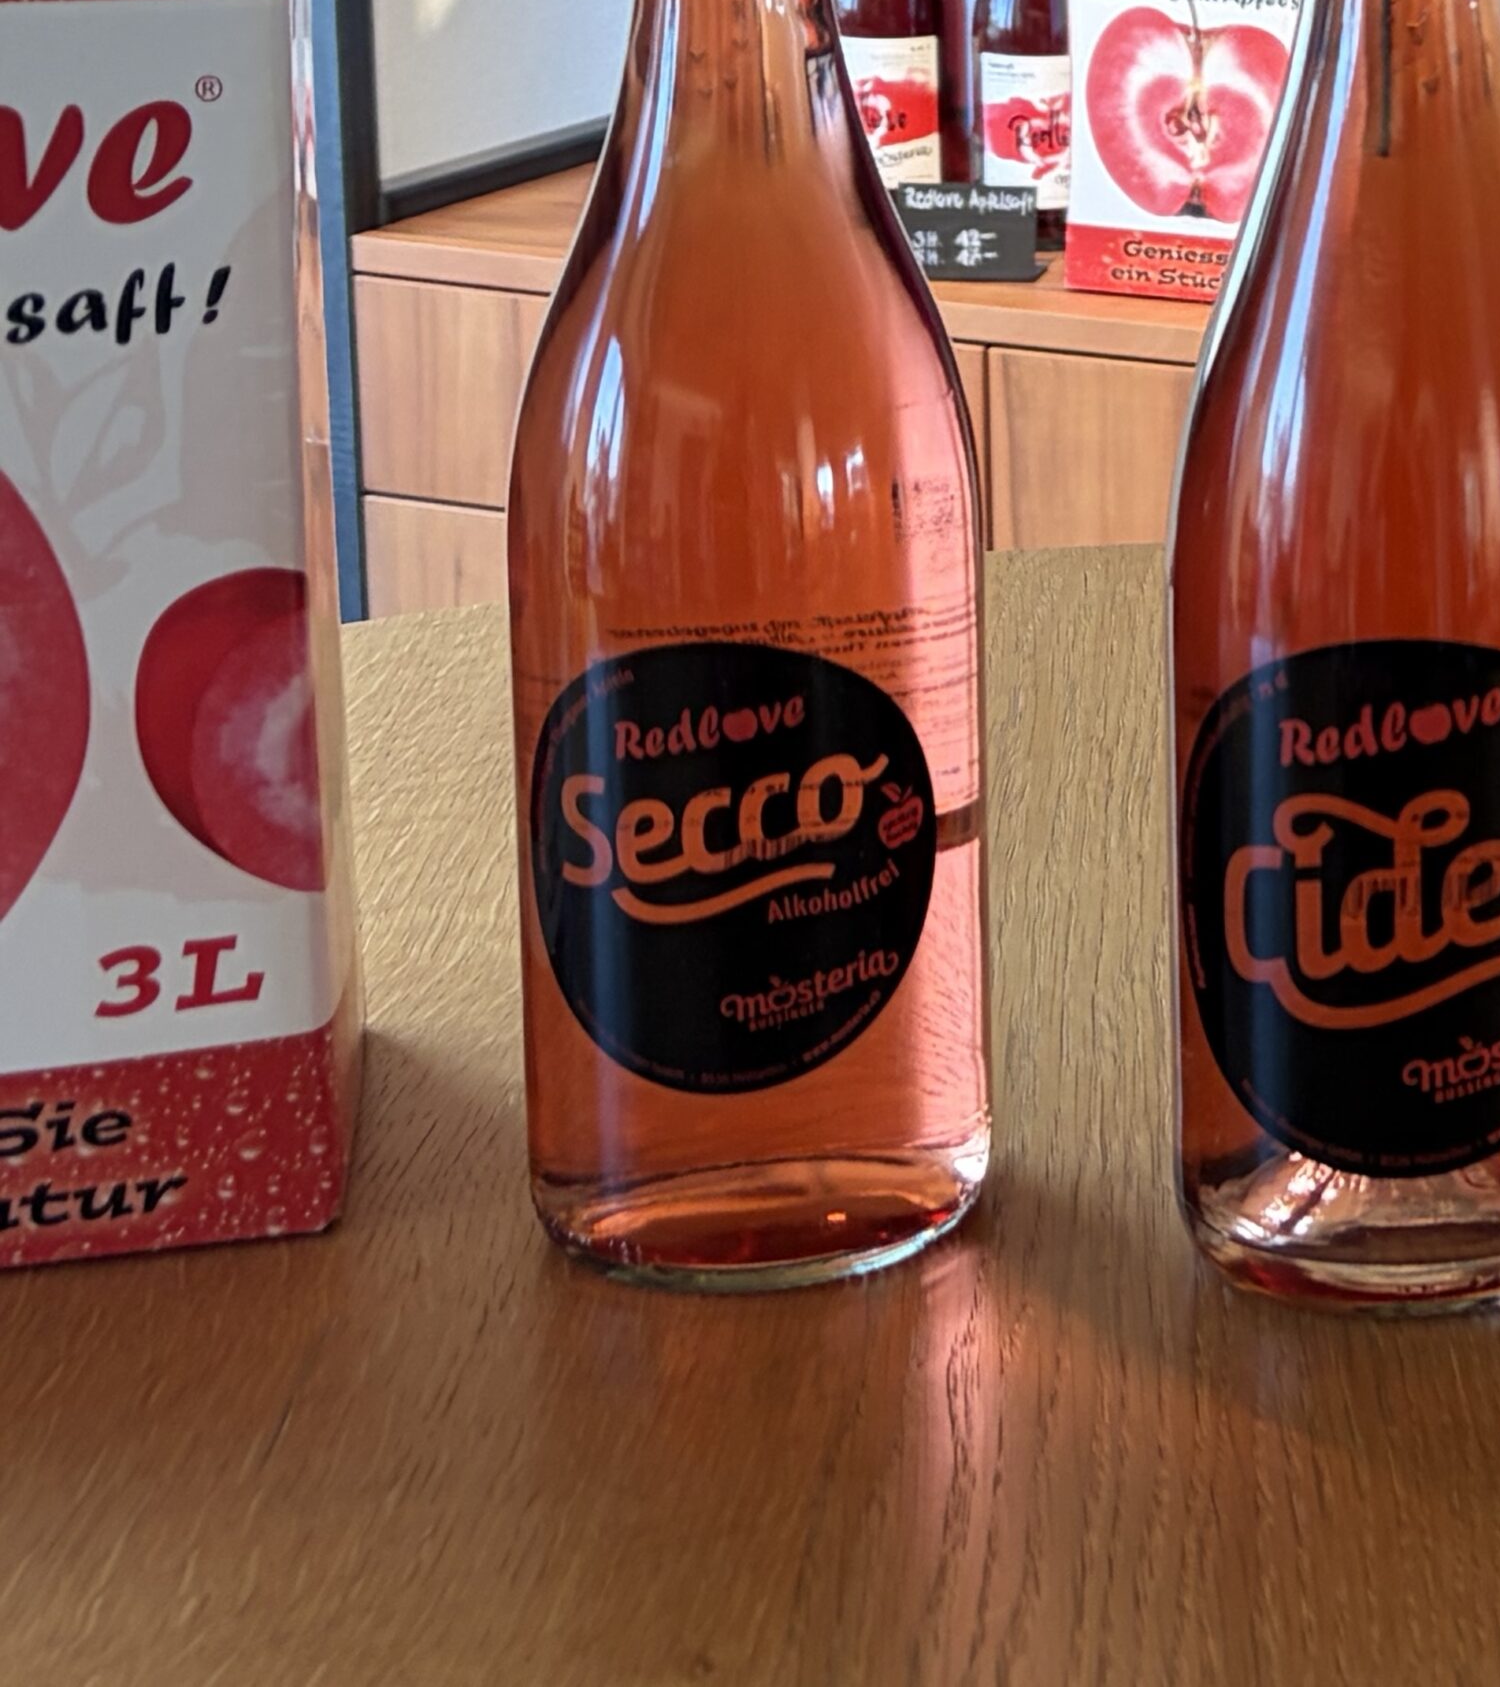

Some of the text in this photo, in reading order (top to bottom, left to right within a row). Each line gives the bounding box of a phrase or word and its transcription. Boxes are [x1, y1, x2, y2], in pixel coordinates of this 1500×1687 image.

[1111, 265, 1222, 290] ein Stüc
[1123, 239, 1230, 267] Geniess
[614, 695, 805, 760] Redlove
[561, 753, 889, 889] Secco
[768, 858, 901, 925] Alkoholfrei
[94, 934, 265, 1019] 3L
[0, 1101, 133, 1157] Sie
